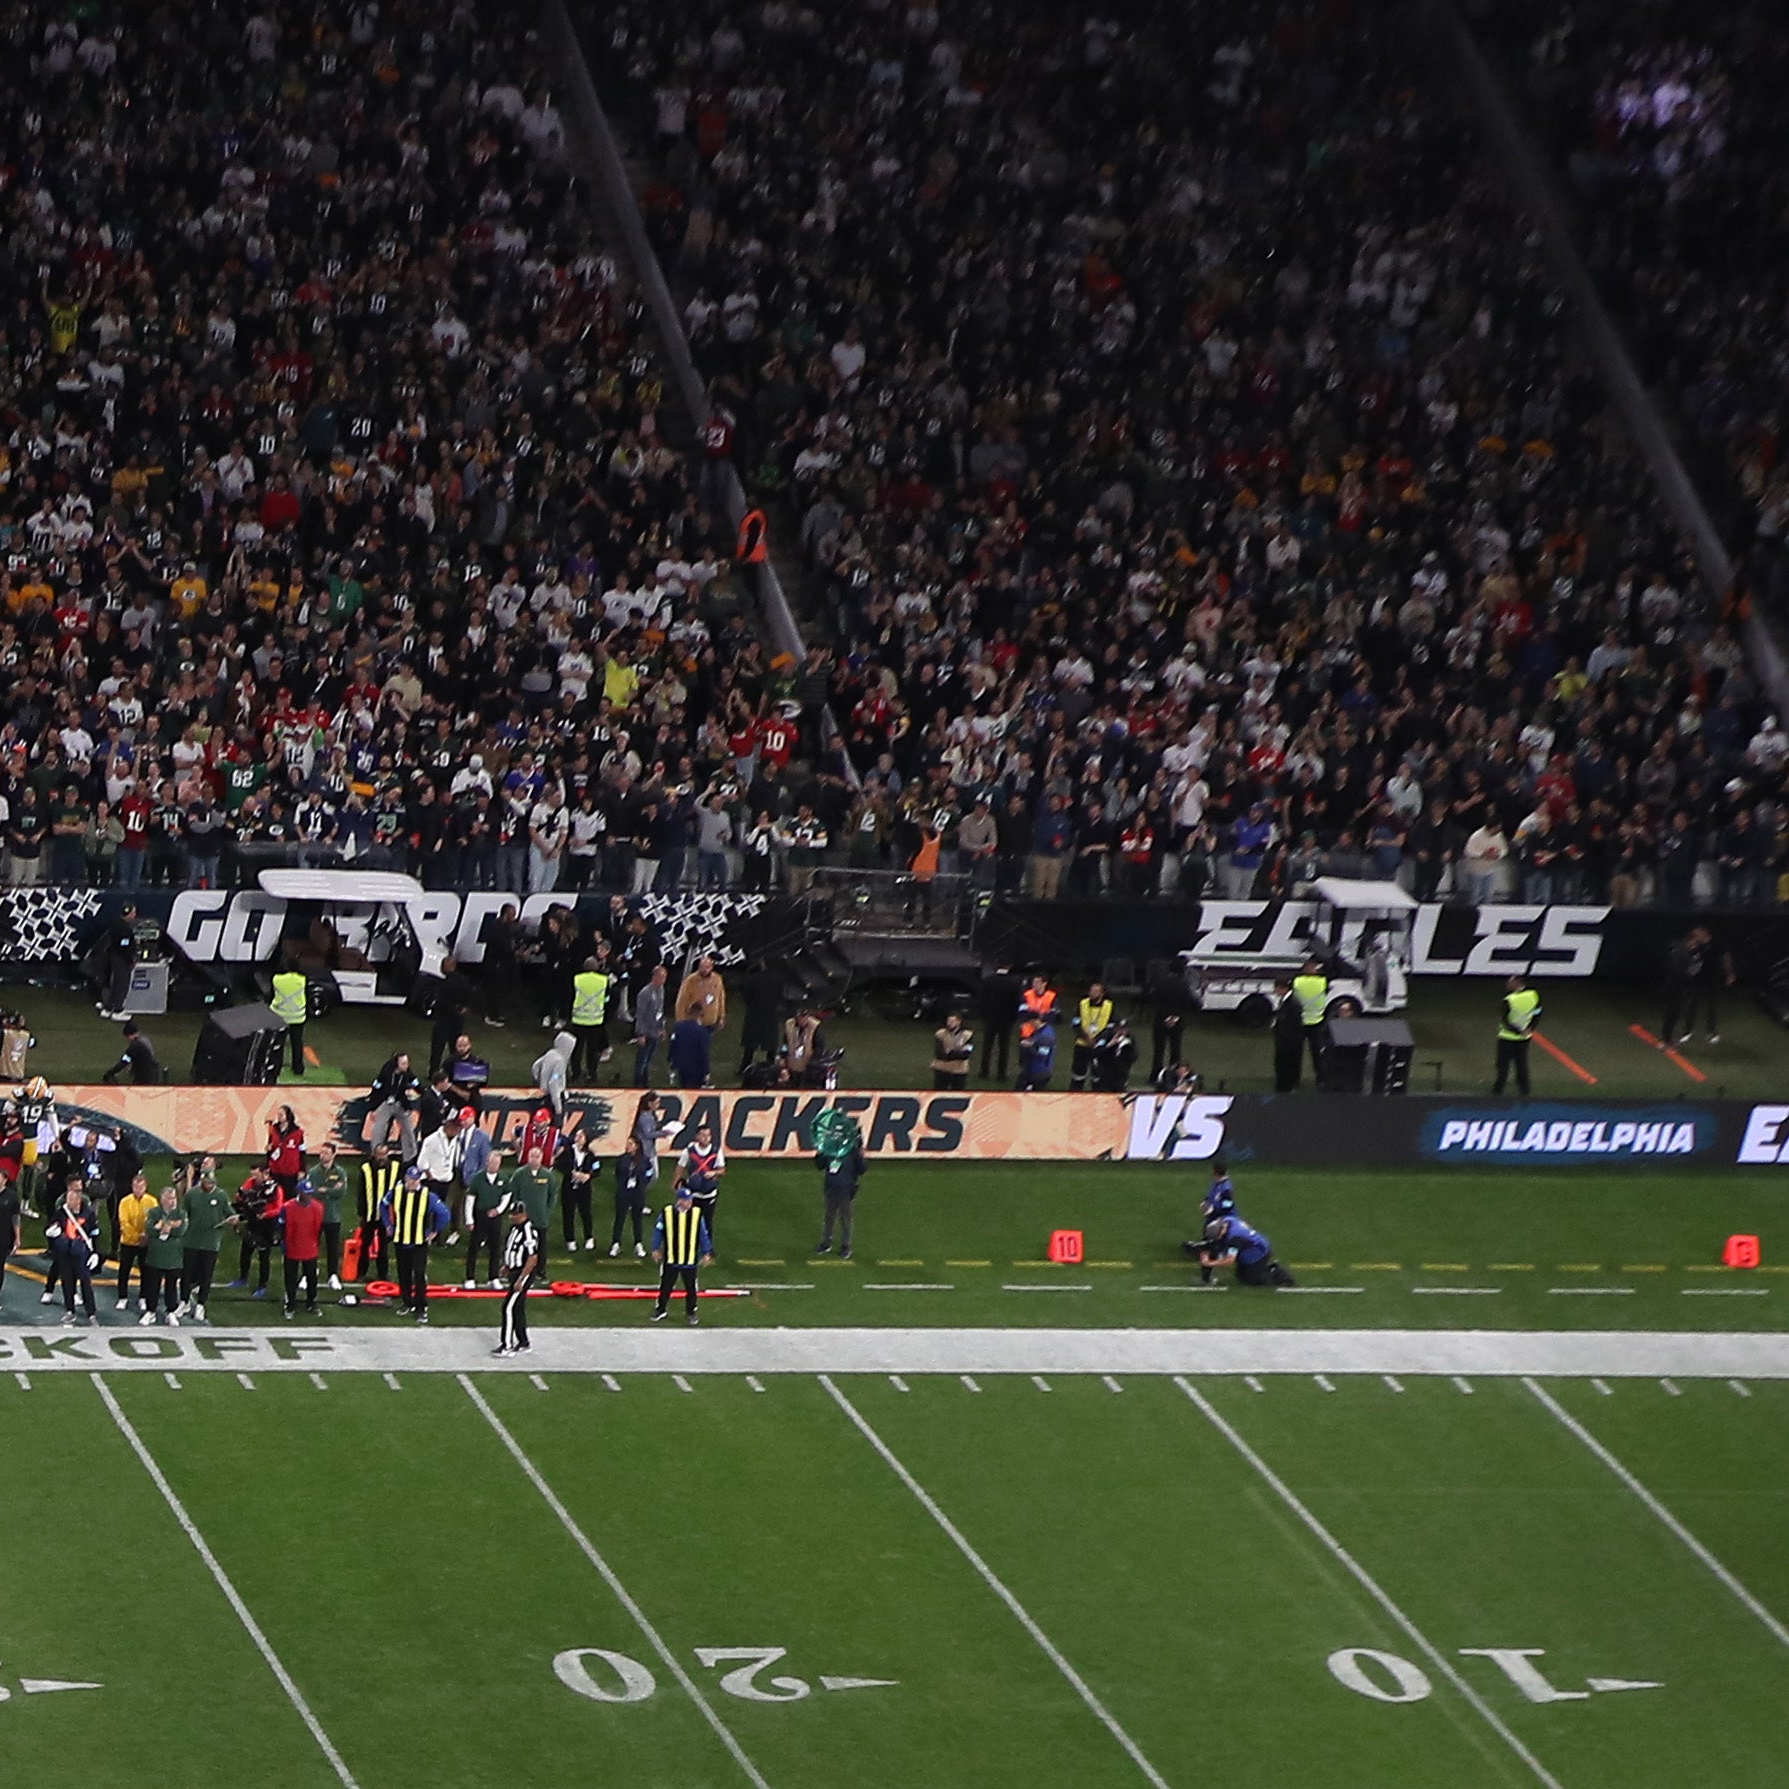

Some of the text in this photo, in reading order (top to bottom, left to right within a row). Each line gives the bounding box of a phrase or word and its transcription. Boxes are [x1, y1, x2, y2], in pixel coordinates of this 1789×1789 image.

[258, 434, 276, 455] 10
[350, 417, 372, 438] 20
[765, 730, 787, 751] 10
[166, 889, 288, 962] GO
[22, 1104, 43, 1124] 19
[1128, 1095, 1235, 1161] VS
[1439, 1104, 1789, 1164] PHILADELPHIA E
[1058, 1236, 1078, 1258] 10
[551, 1646, 810, 1702] 20
[1326, 1646, 1590, 1703] 10
